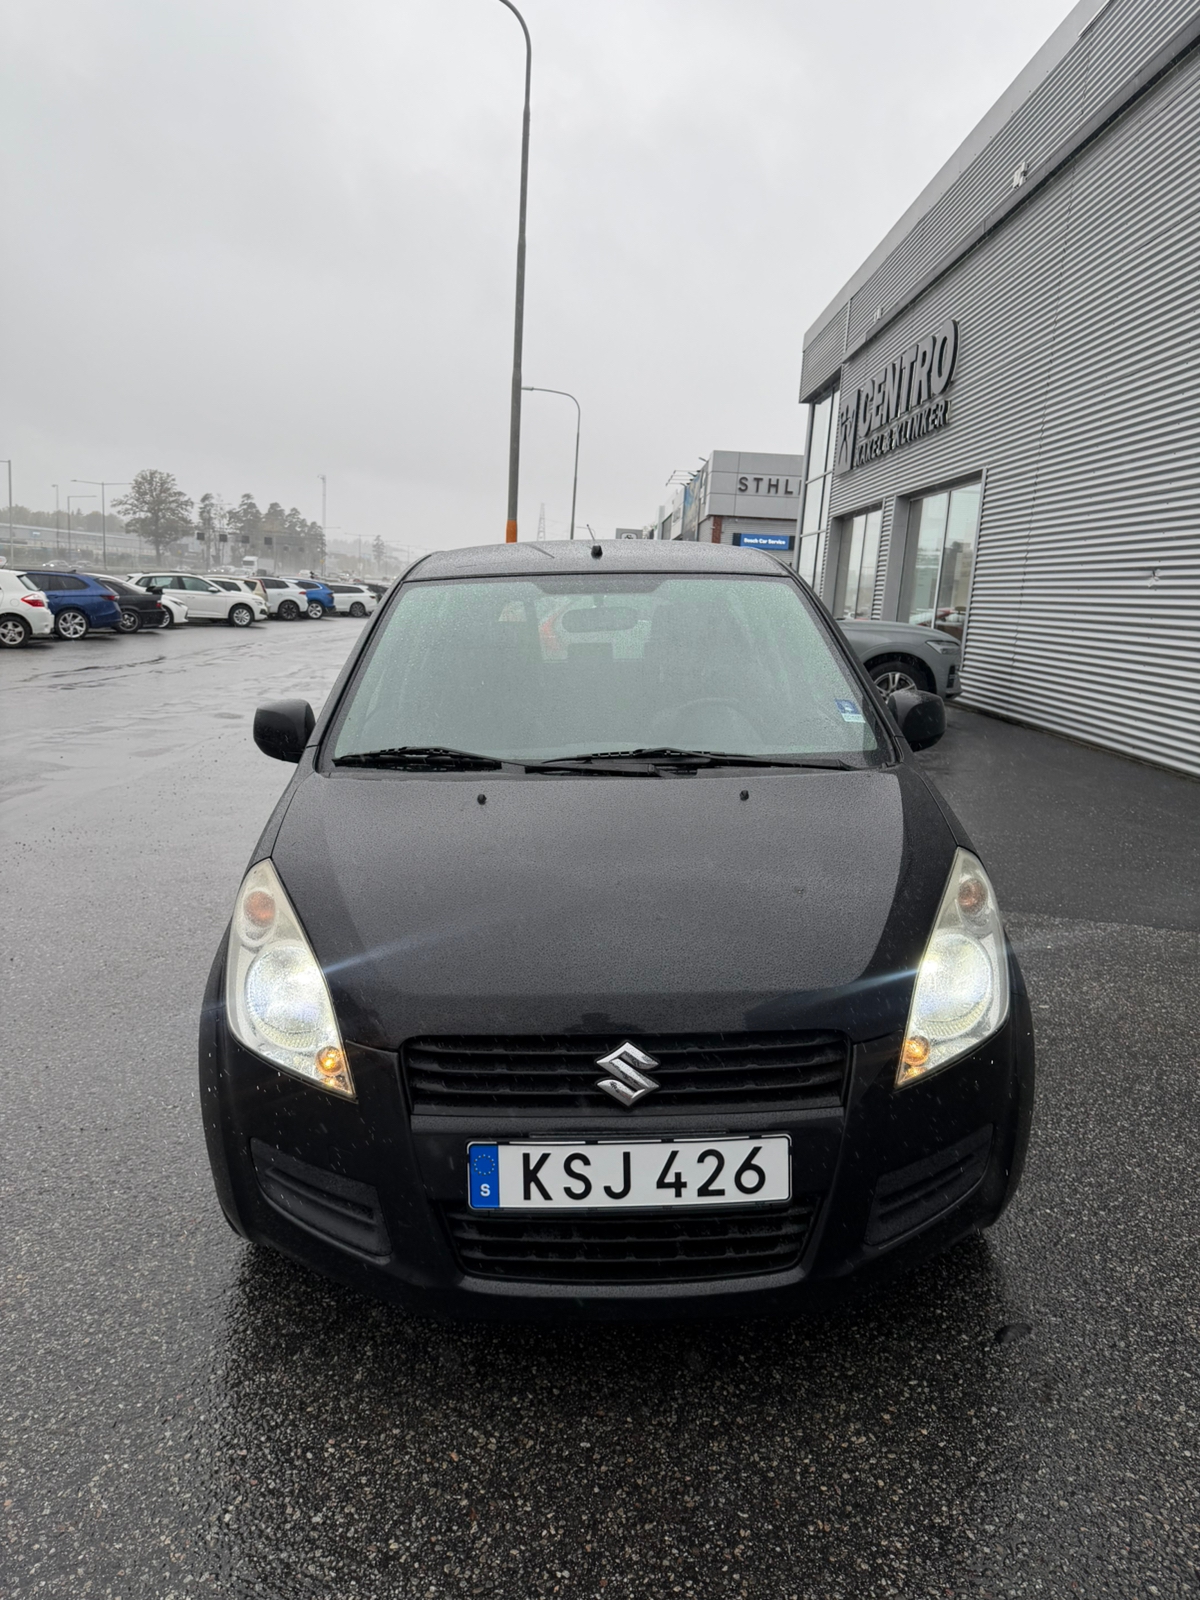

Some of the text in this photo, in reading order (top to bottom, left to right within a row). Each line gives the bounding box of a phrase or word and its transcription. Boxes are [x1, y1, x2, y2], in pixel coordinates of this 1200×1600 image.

[857, 319, 958, 438] CENTRO
[854, 433, 885, 467] KAKEL
[892, 399, 950, 450] KLINKER
[738, 476, 802, 496] STHL
[479, 1183, 491, 1197] S
[521, 1146, 767, 1202] KSJ 426
